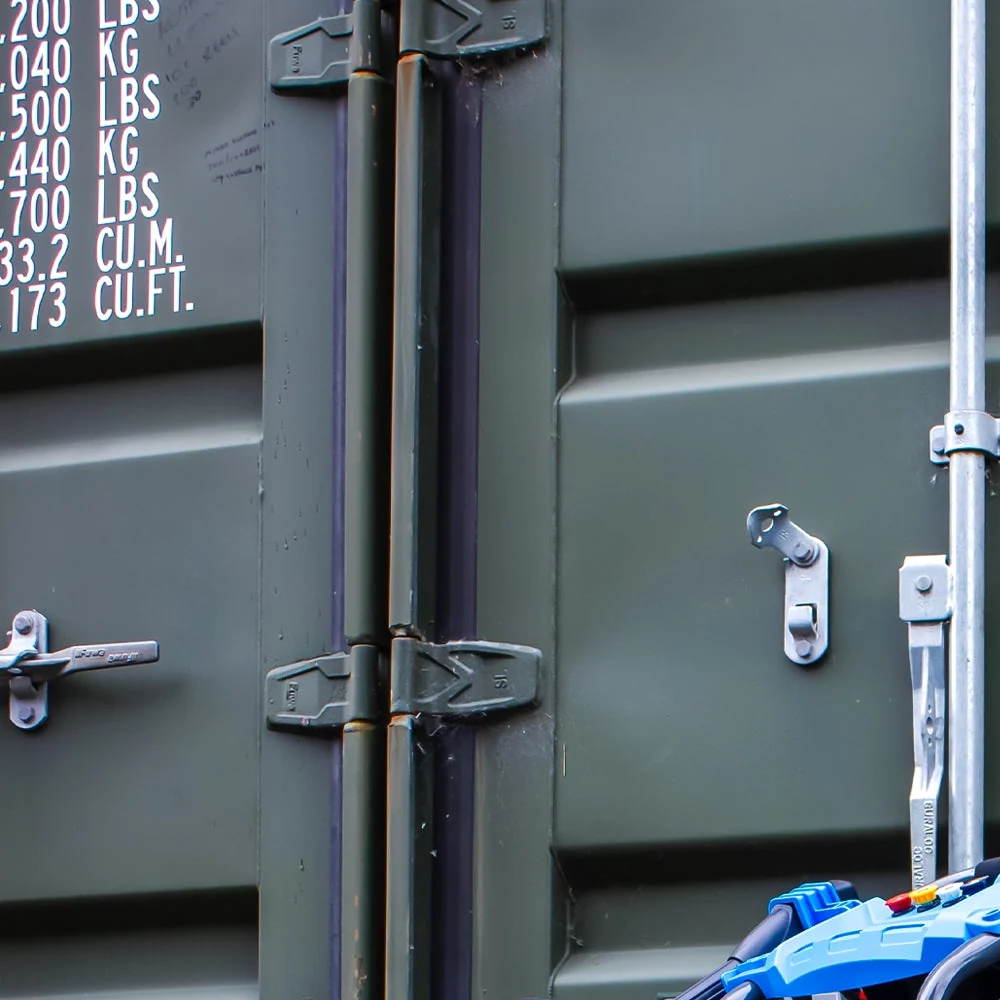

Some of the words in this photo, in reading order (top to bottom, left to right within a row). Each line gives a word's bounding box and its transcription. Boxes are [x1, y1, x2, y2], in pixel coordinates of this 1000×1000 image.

[98, 27, 139, 78] KG
[98, 73, 161, 127] LBS
[98, 126, 139, 176] KG
[97, 172, 160, 225] LBS
[96, 217, 183, 272] CU.M.
[94, 265, 194, 321] CU.FT.
